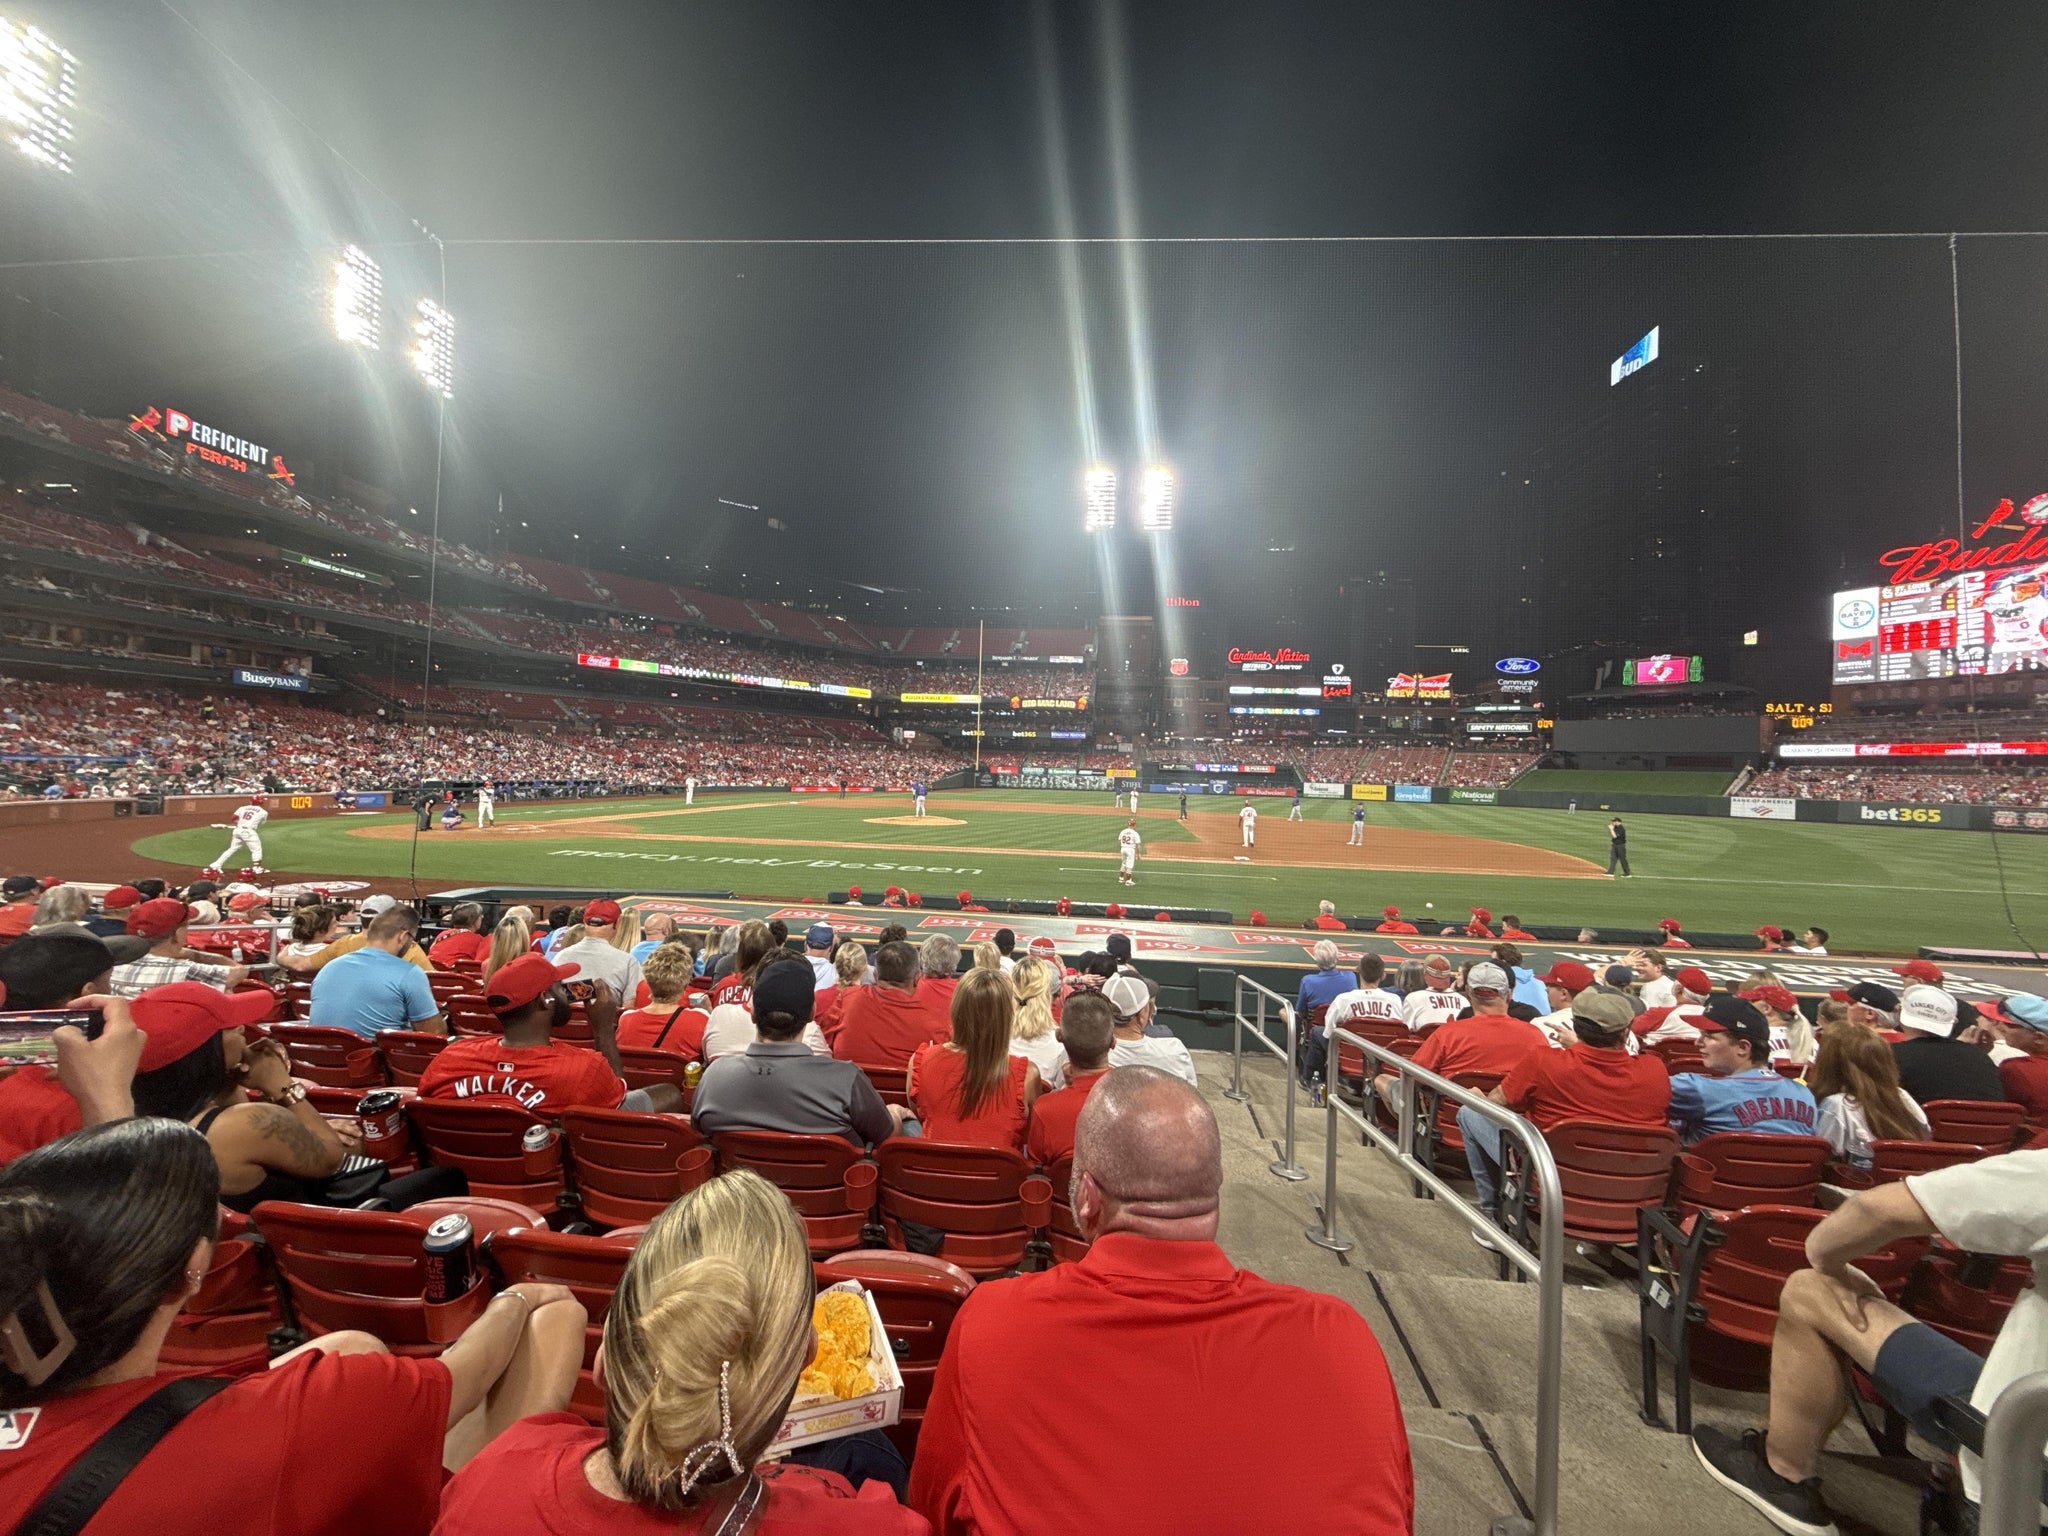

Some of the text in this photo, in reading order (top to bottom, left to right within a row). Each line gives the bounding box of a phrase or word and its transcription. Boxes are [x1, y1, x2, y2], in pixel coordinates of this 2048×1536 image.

[166, 407, 269, 466] PERFICIENT
[1165, 597, 1200, 607] Hilton
[1228, 647, 1310, 664] Cardinals Nation
[1504, 658, 1532, 672] Ford
[1765, 703, 1804, 713] SALT
[1012, 730, 1037, 738] bet365
[1121, 780, 1142, 788] STIFEL
[1461, 790, 1496, 800] National
[242, 810, 255, 820] 16
[1860, 805, 1942, 823] bet365
[1121, 835, 1131, 844] 82
[832, 923, 874, 932] 942
[718, 985, 754, 1004] AREN
[1350, 1000, 1393, 1017] PUJOLS
[1428, 995, 1461, 1010] SMITH
[454, 1075, 546, 1110] WALKER
[1732, 1097, 1815, 1128] ARENADO
